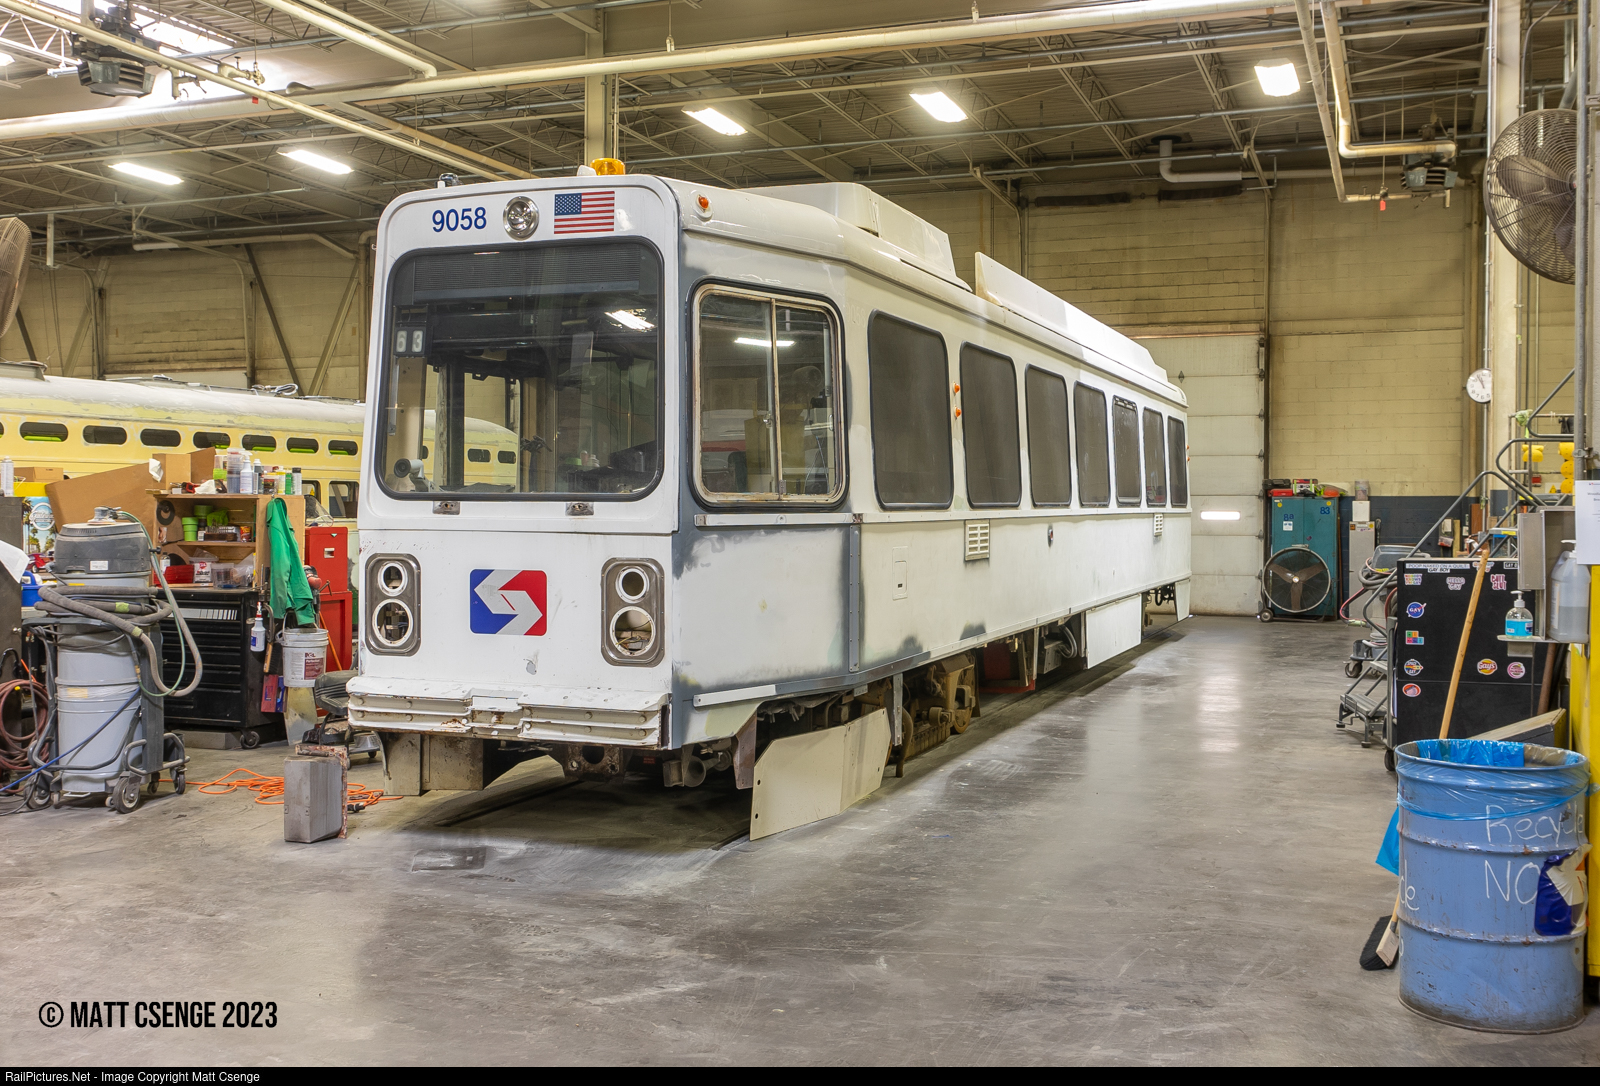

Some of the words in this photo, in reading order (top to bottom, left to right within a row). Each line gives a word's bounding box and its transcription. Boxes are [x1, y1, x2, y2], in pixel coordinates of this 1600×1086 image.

[432, 206, 487, 233] 9058
[396, 330, 423, 353] 63
[1320, 506, 1330, 515] 83
